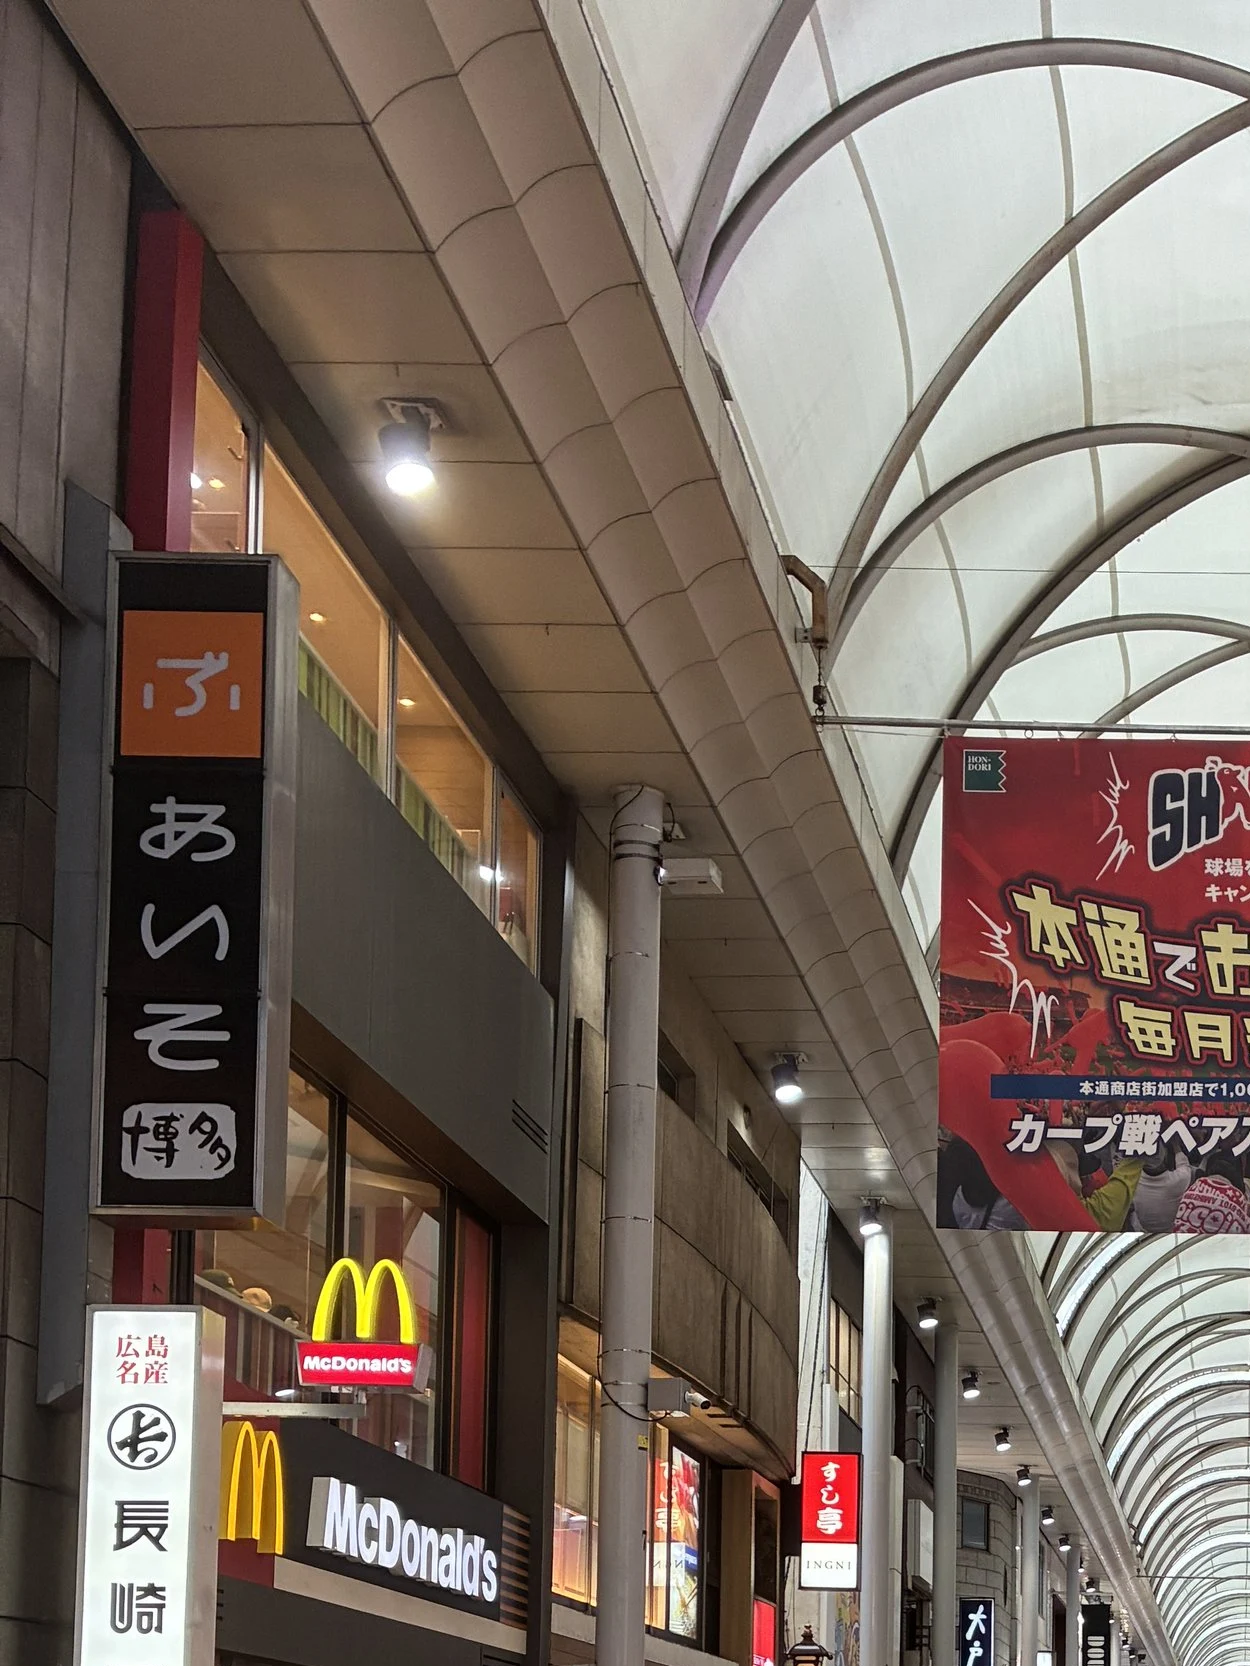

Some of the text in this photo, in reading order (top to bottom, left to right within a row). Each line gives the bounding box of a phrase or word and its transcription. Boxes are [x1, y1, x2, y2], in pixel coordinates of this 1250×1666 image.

[967, 764, 992, 772] DORI
[121, 1109, 233, 1172] 博多
[115, 1333, 169, 1358] 広島
[115, 1359, 169, 1386] 名産
[302, 1354, 413, 1375] McDonald's
[816, 1461, 844, 1535] すし亭
[323, 1477, 498, 1603] McDonald's
[806, 1559, 852, 1571] INGNI
